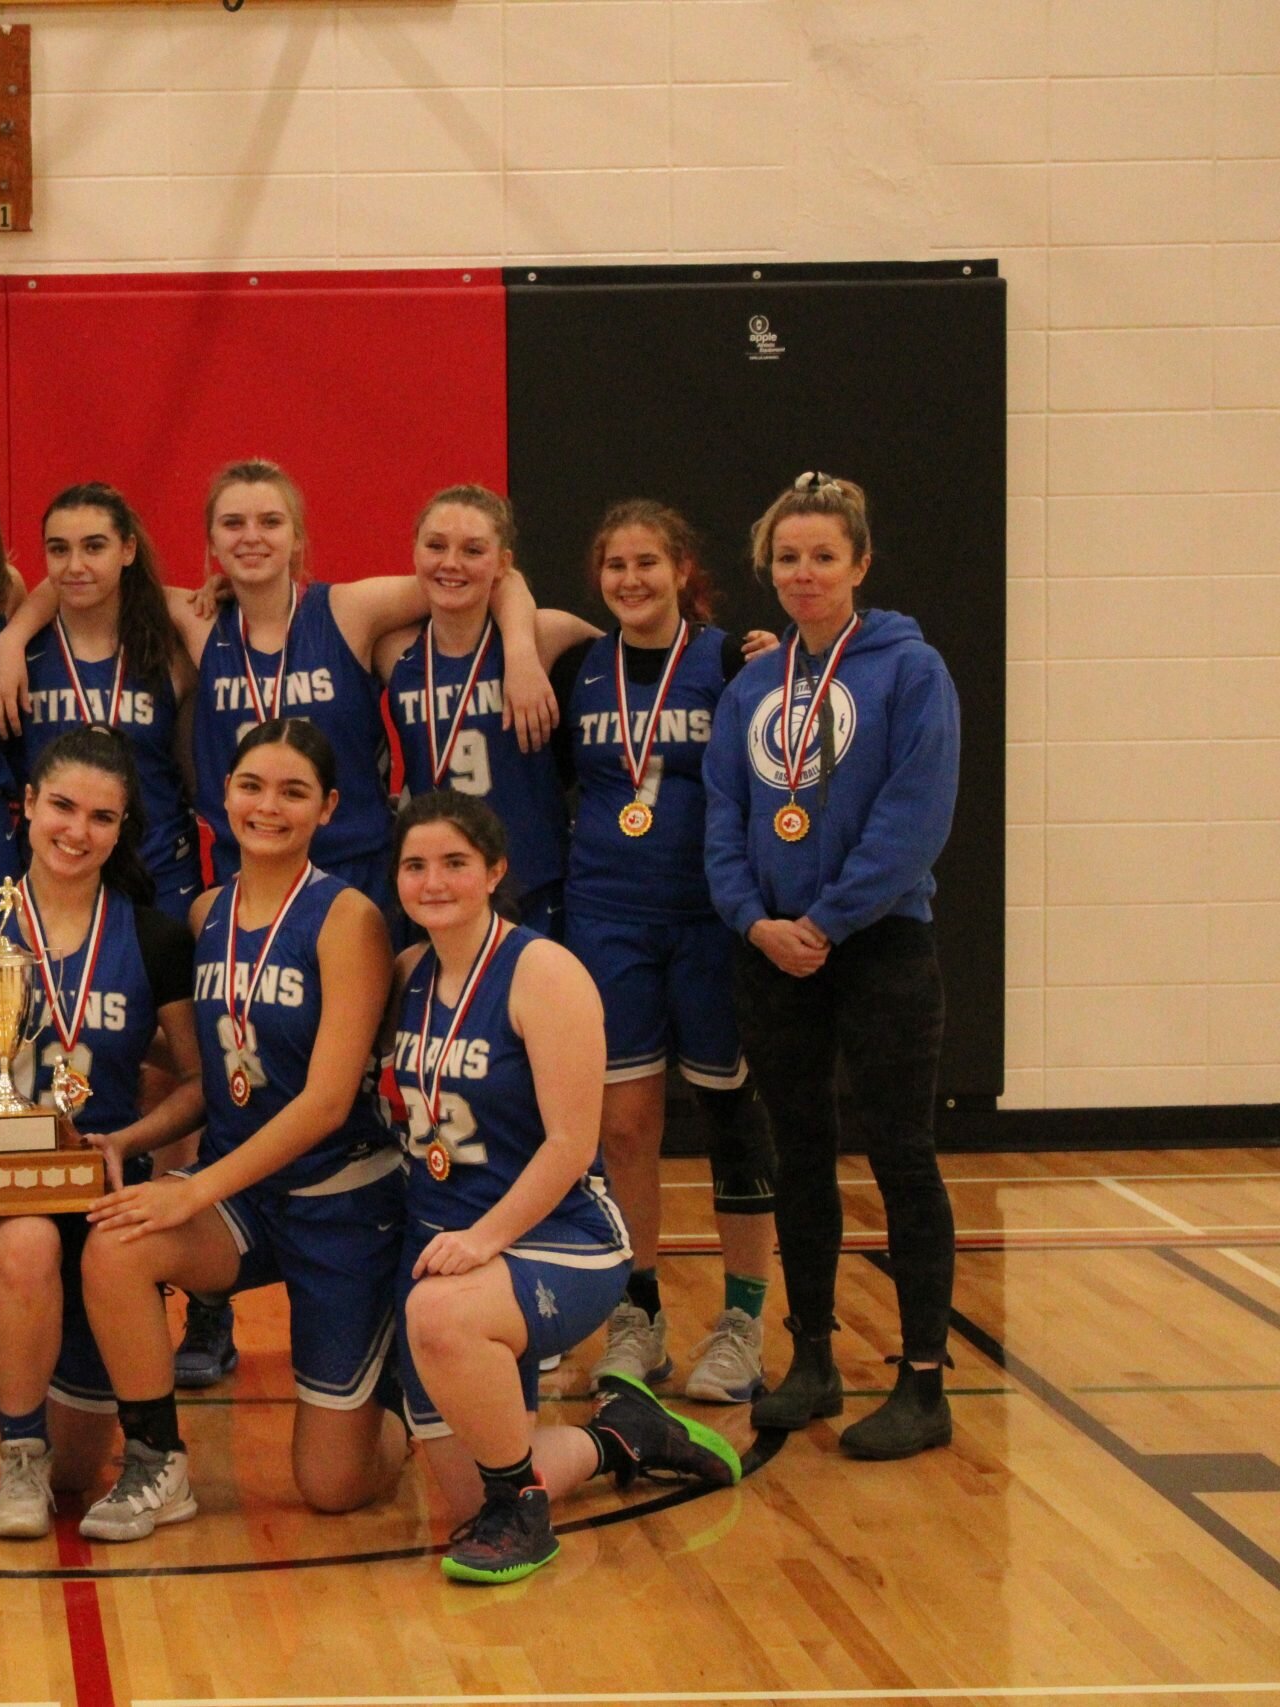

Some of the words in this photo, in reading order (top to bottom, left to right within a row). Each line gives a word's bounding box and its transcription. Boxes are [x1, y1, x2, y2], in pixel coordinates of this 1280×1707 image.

[0, 206, 10, 228] 1
[749, 332, 778, 343] apple
[448, 728, 493, 797] 9
[399, 1085, 489, 1166] 22
